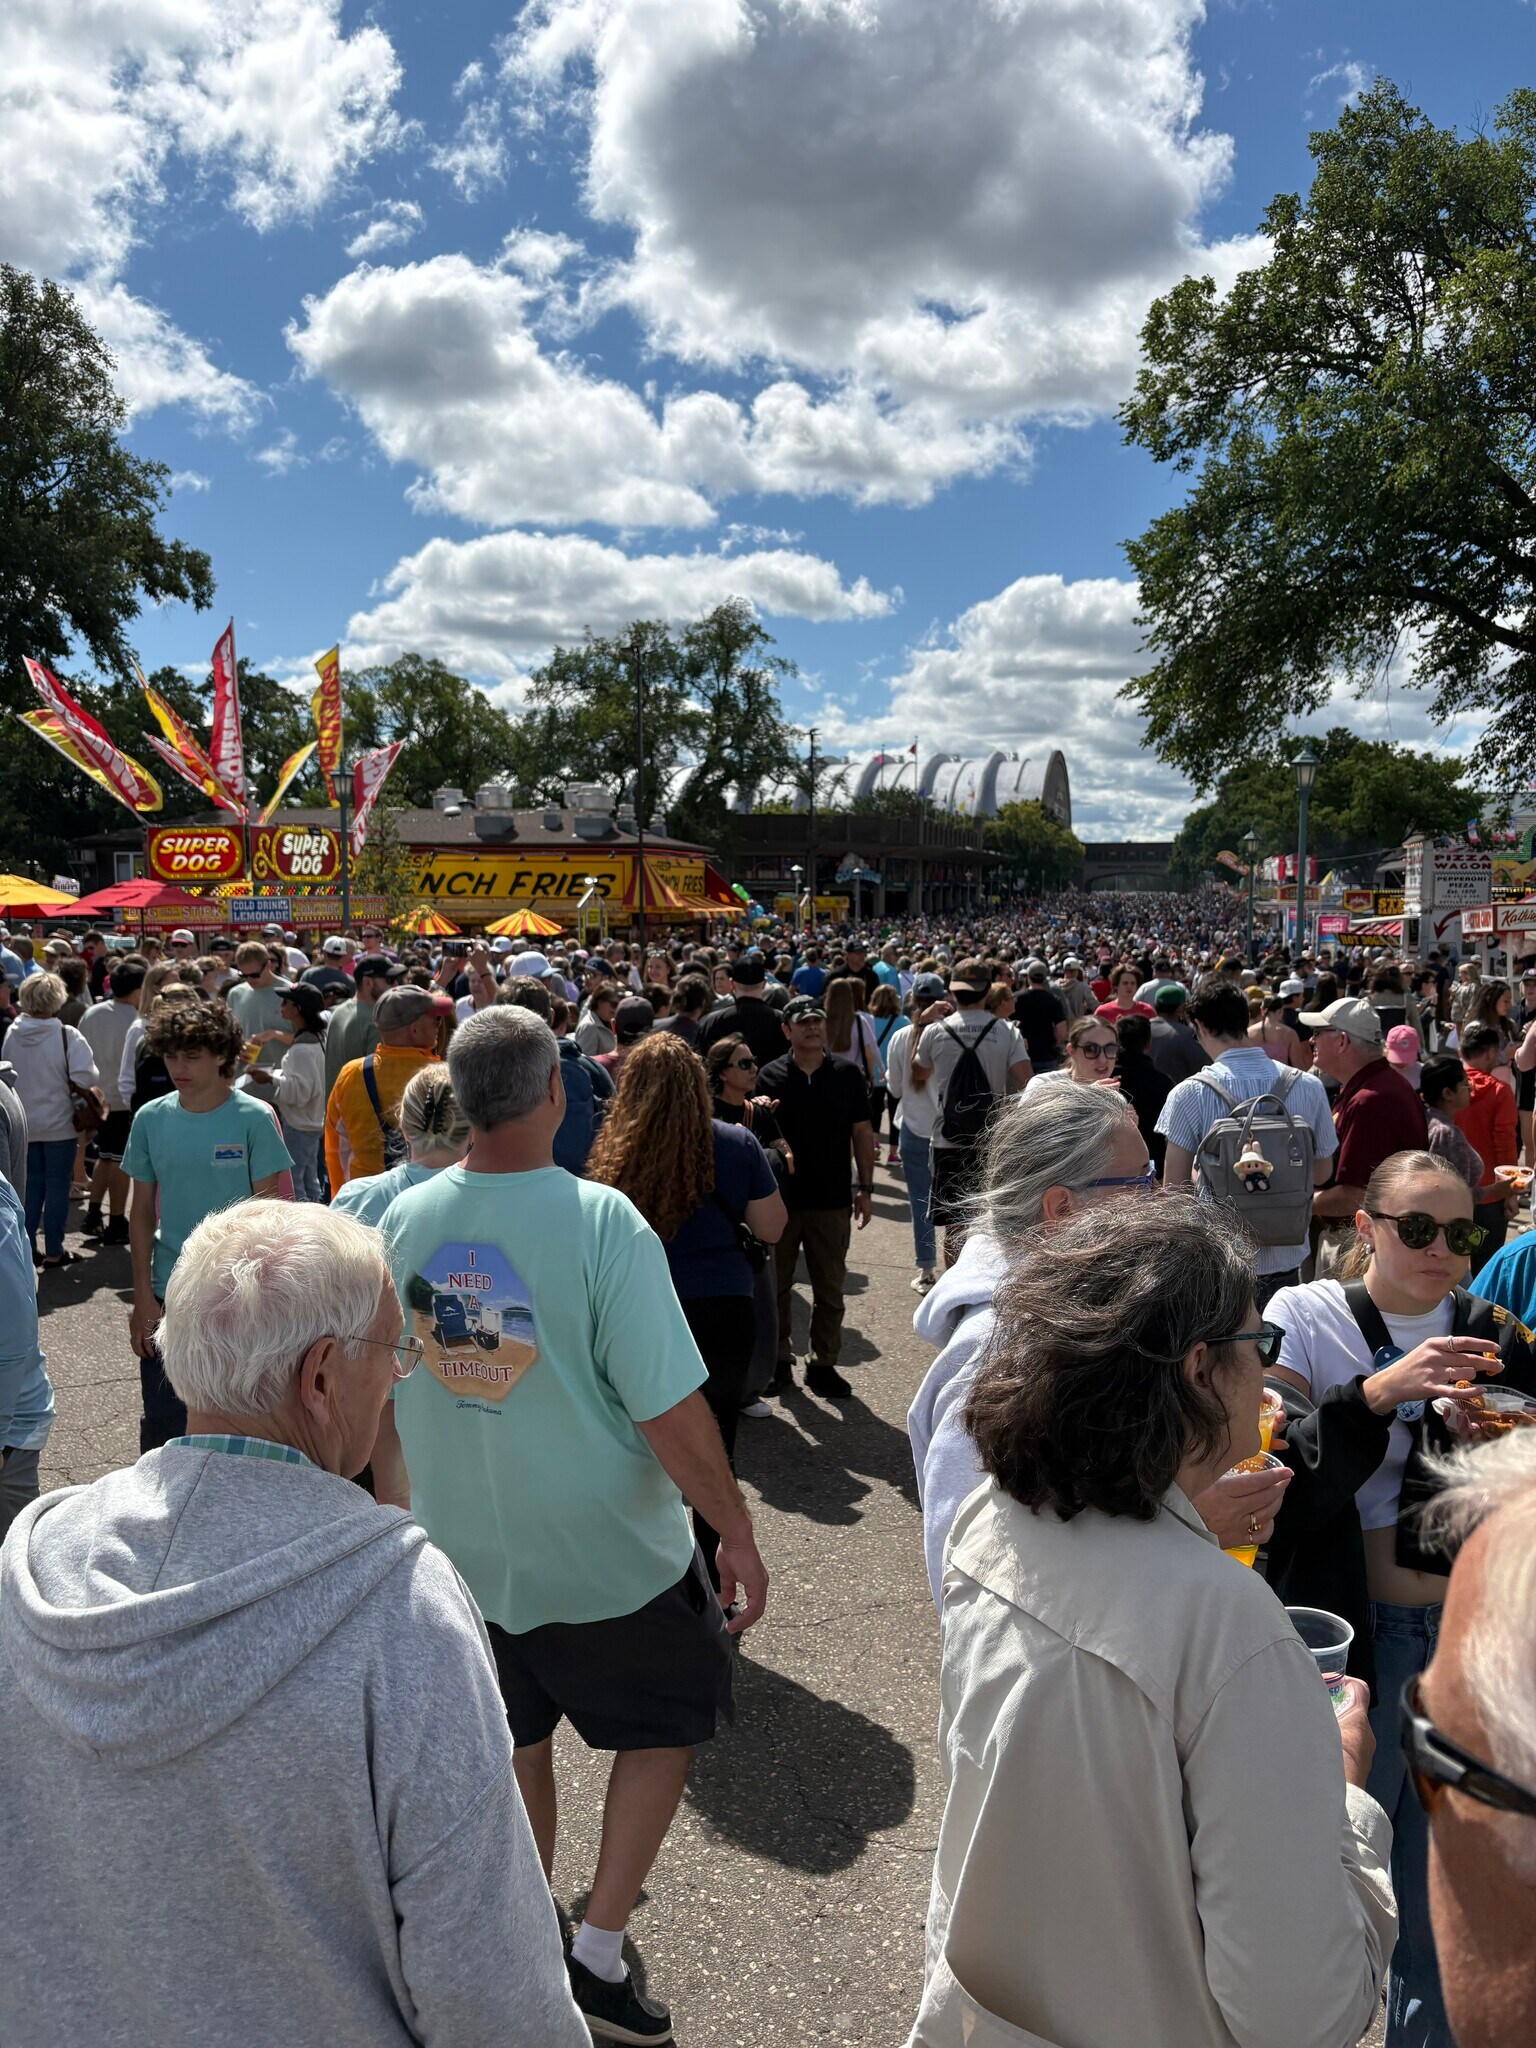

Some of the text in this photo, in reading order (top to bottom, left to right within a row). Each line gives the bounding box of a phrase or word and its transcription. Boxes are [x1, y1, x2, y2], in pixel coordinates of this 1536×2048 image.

[160, 837, 230, 854] SUPER
[281, 832, 330, 856] SUPER
[170, 854, 222, 872] DOG
[290, 854, 323, 876] DOG
[1434, 854, 1491, 862] PIZZA
[1434, 862, 1492, 870] WAGON
[507, 870, 618, 897] FRIES
[683, 874, 704, 893] FRIES
[182, 905, 222, 918] STICK
[232, 899, 289, 911] COLD DRINKS
[233, 910, 289, 921] LEMONADE
[468, 1250, 476, 1268] I
[447, 1272, 493, 1292] NEED
[469, 1294, 480, 1311] A
[438, 1361, 513, 1383] TIMEOUT
